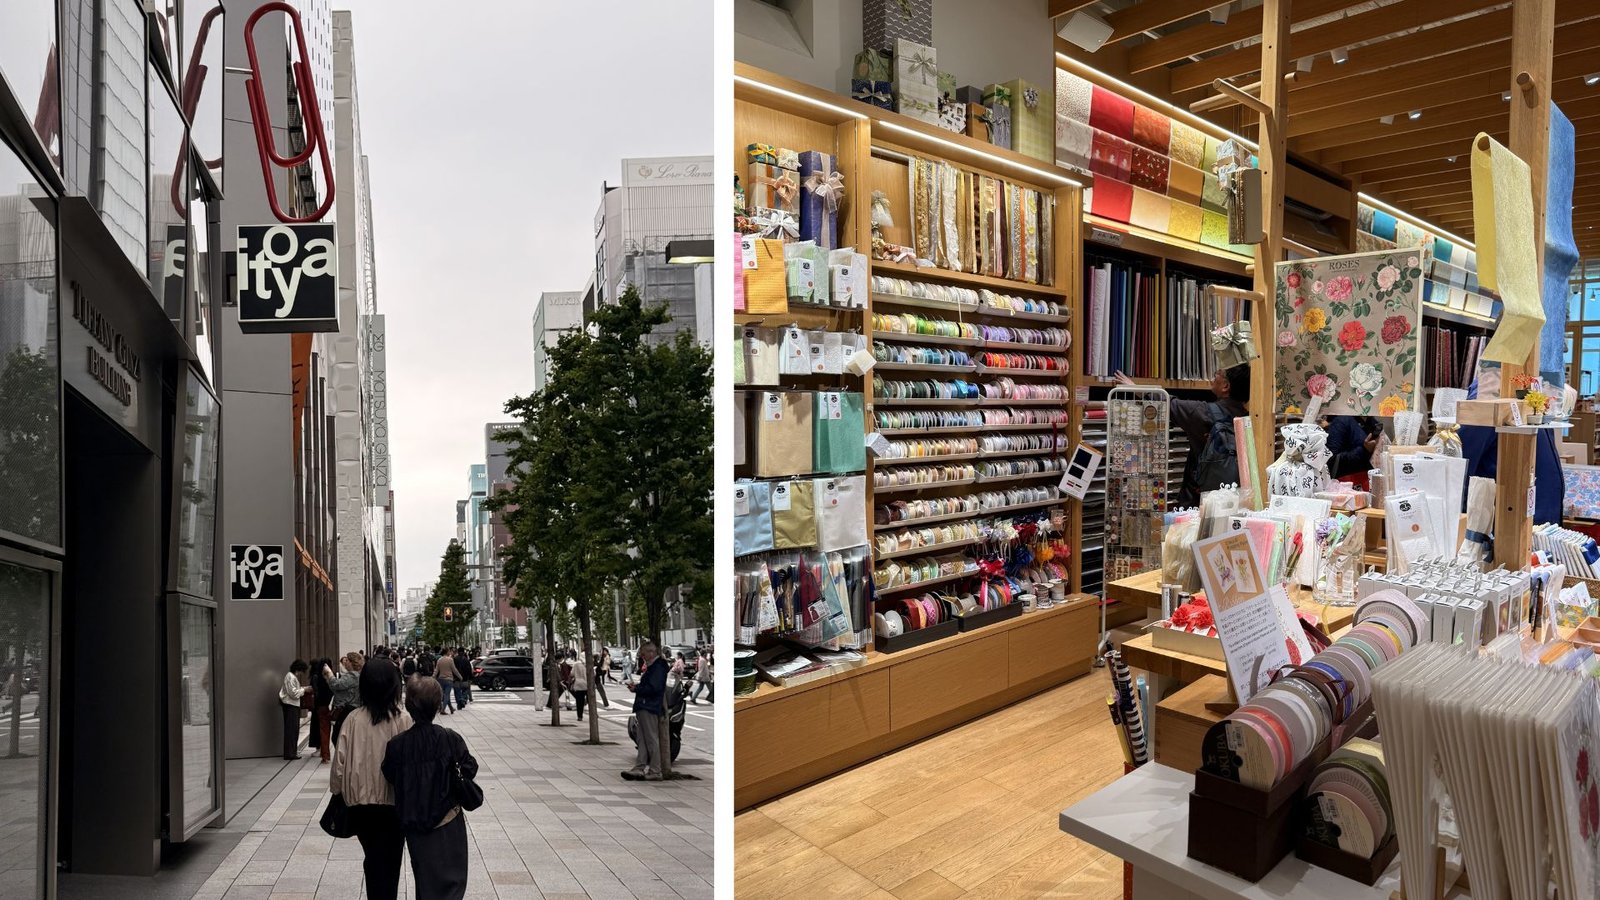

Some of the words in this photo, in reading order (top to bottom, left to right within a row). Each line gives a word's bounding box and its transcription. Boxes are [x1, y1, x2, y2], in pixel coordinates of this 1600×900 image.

[238, 225, 336, 318] itoya
[1328, 259, 1360, 271] ROSES
[87, 345, 132, 406] BUILDING
[115, 333, 142, 382] GINZ
[231, 545, 283, 599] itoya
